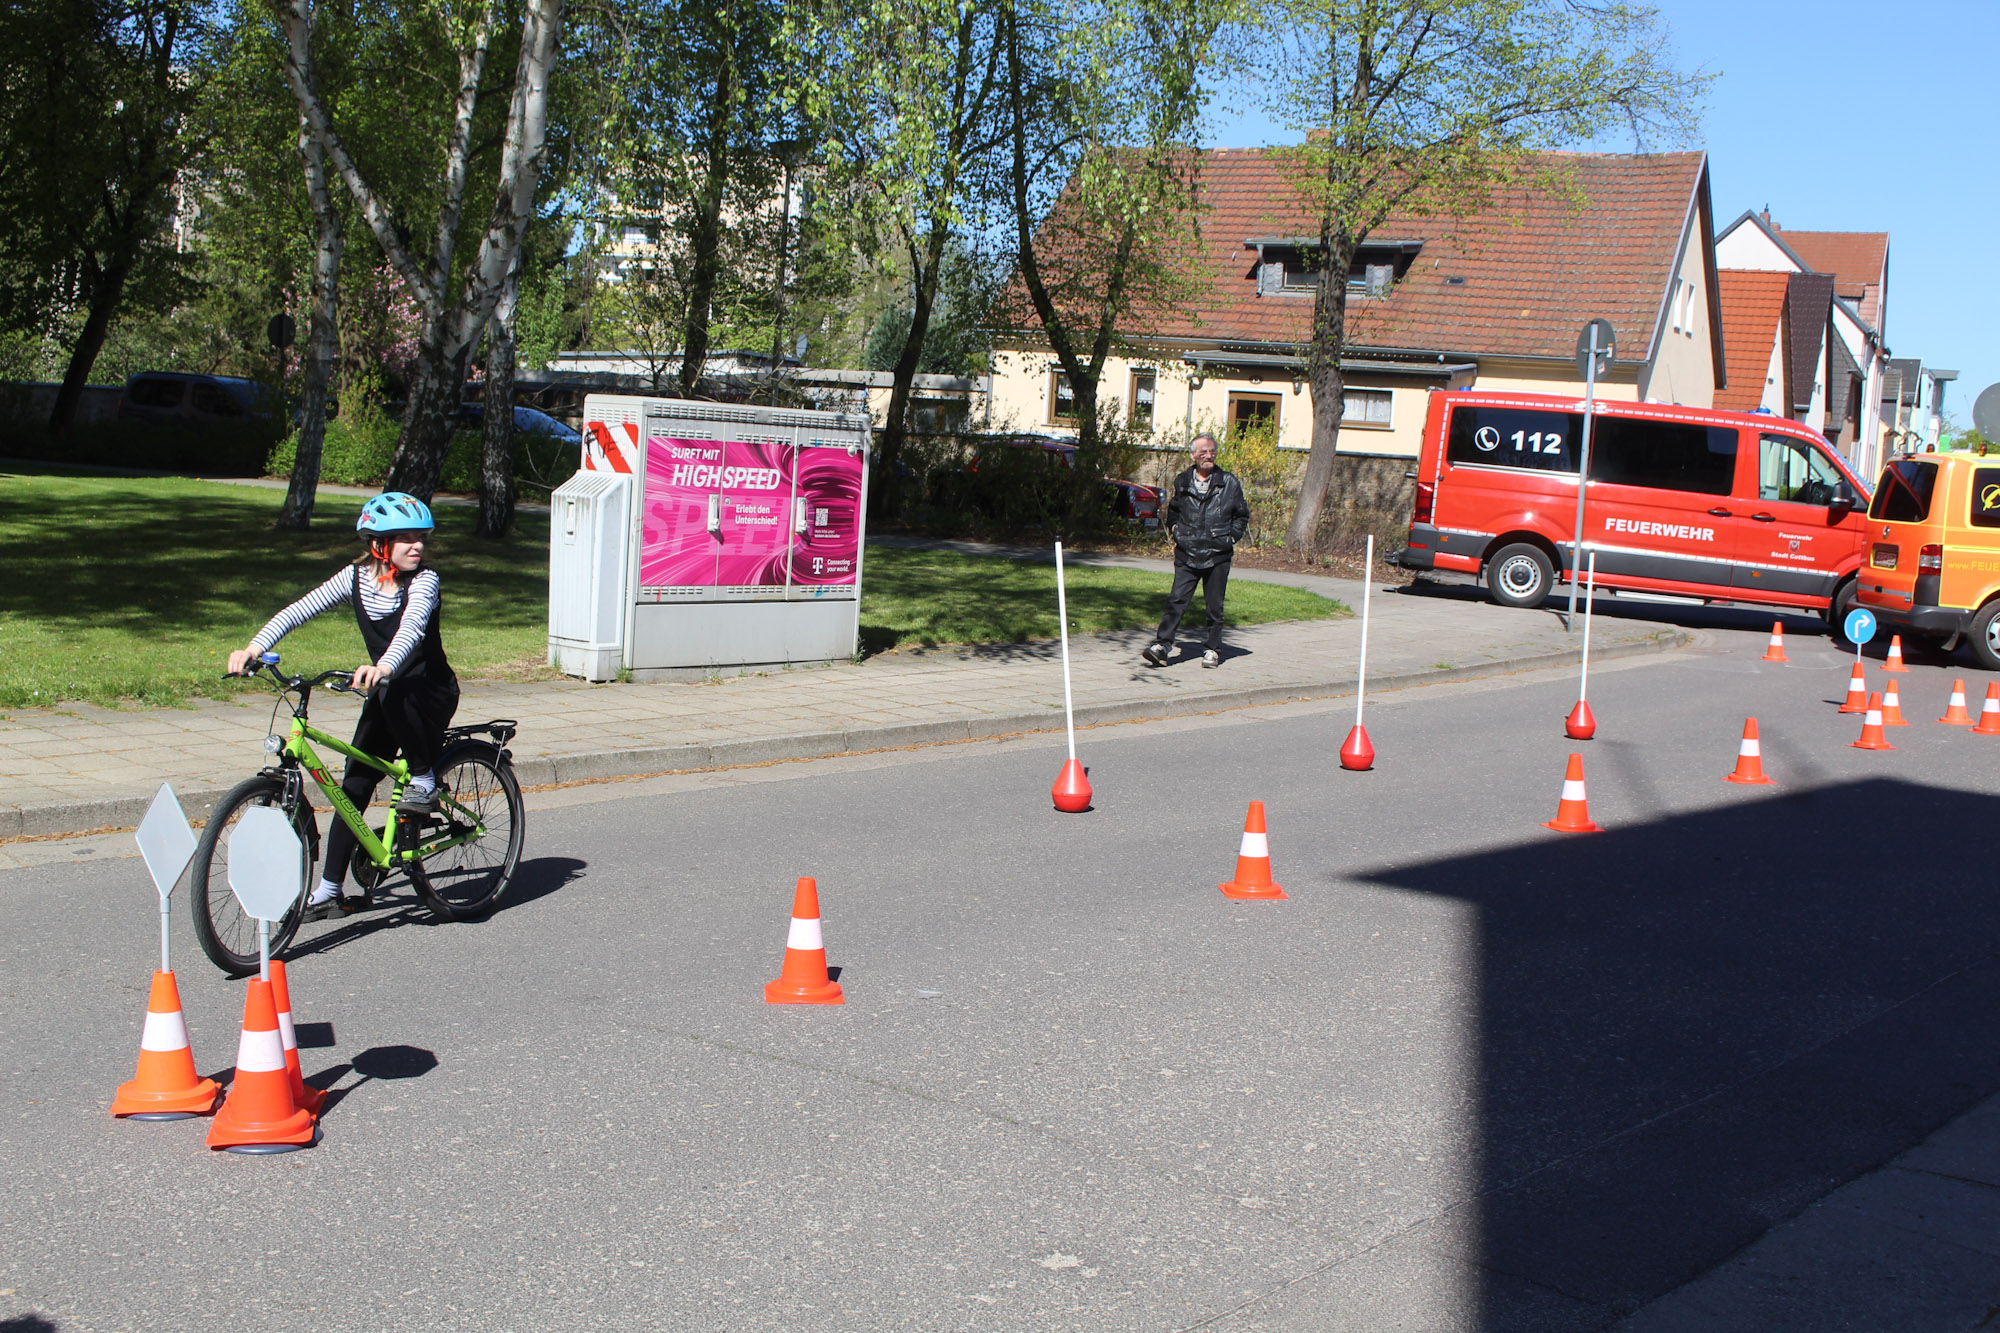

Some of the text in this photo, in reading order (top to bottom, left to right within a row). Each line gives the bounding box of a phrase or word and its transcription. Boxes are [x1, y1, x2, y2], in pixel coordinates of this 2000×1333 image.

[1511, 430, 1562, 454] 112
[671, 447, 720, 461] SURFT MIT
[736, 504, 770, 514] Erlebt den
[735, 515, 778, 525] Unterschied!
[1605, 517, 1714, 541] FEUERWEHR
[1778, 532, 1813, 541] Feuerwehr
[1771, 551, 1816, 562] Stadt Cottbus
